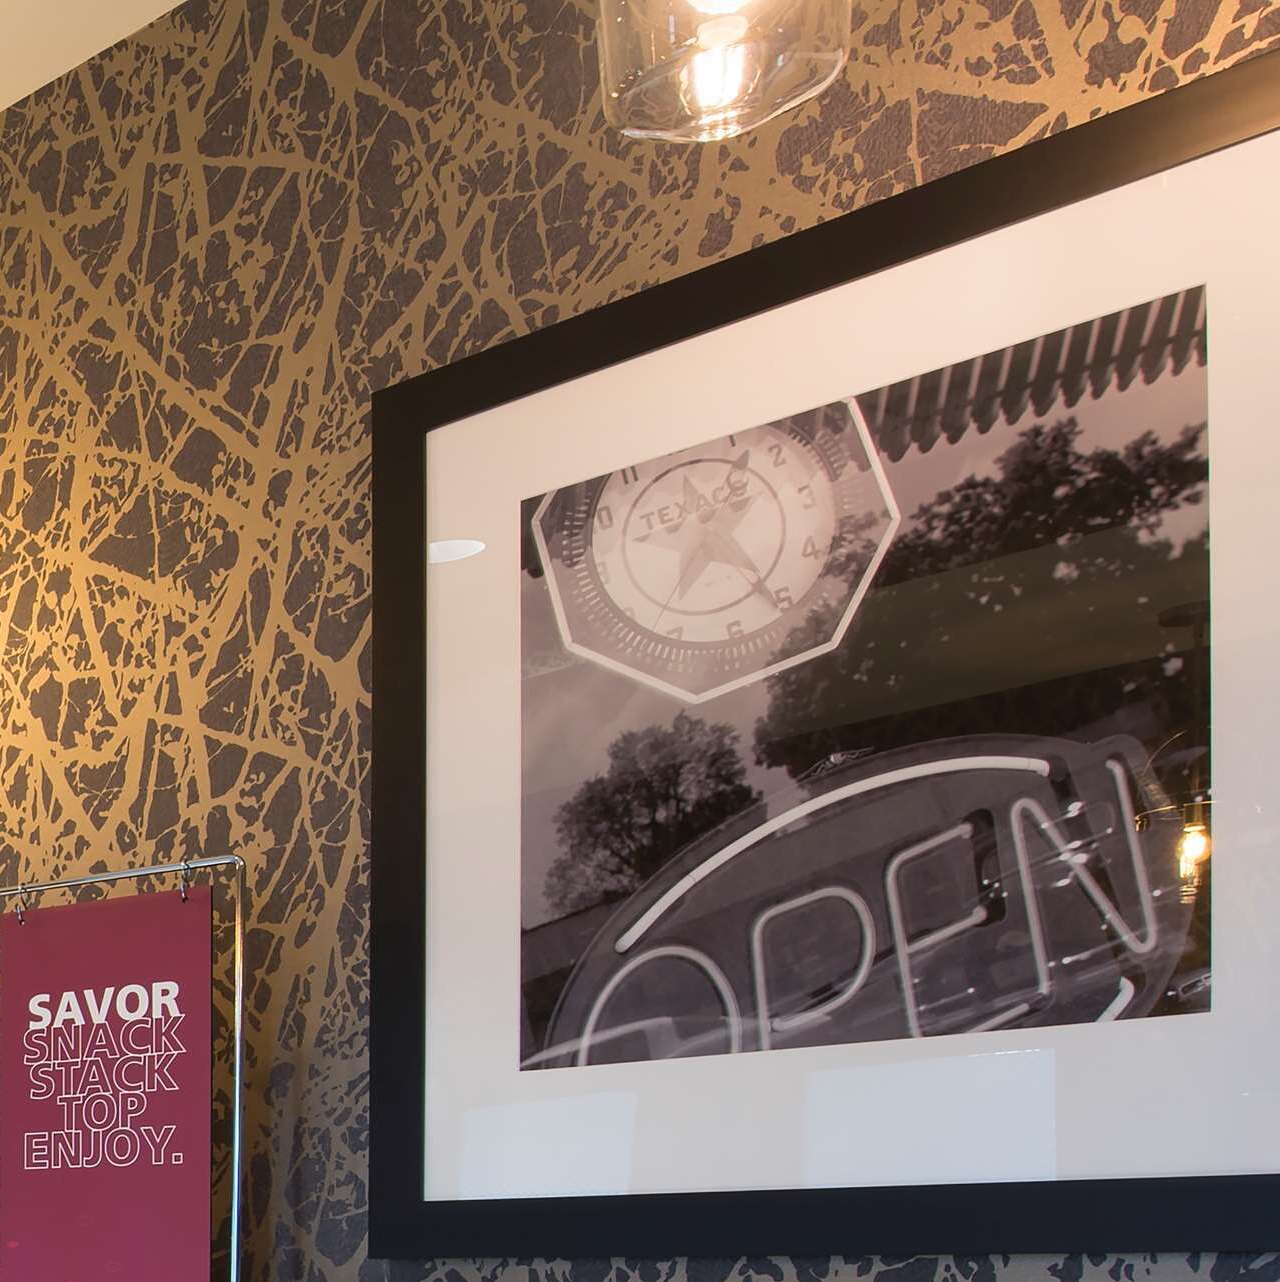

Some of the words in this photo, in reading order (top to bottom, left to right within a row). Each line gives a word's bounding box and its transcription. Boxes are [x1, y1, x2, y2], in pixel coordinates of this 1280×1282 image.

[639, 474, 750, 531] TEXACO
[800, 535, 824, 560] 4
[575, 757, 1158, 1068] OPEN
[28, 980, 181, 1030] SAVOR
[22, 1013, 187, 1065] SNACK
[29, 1051, 180, 1100] STACK
[56, 1091, 148, 1133] TOP
[23, 1125, 184, 1170] ENJOY.
